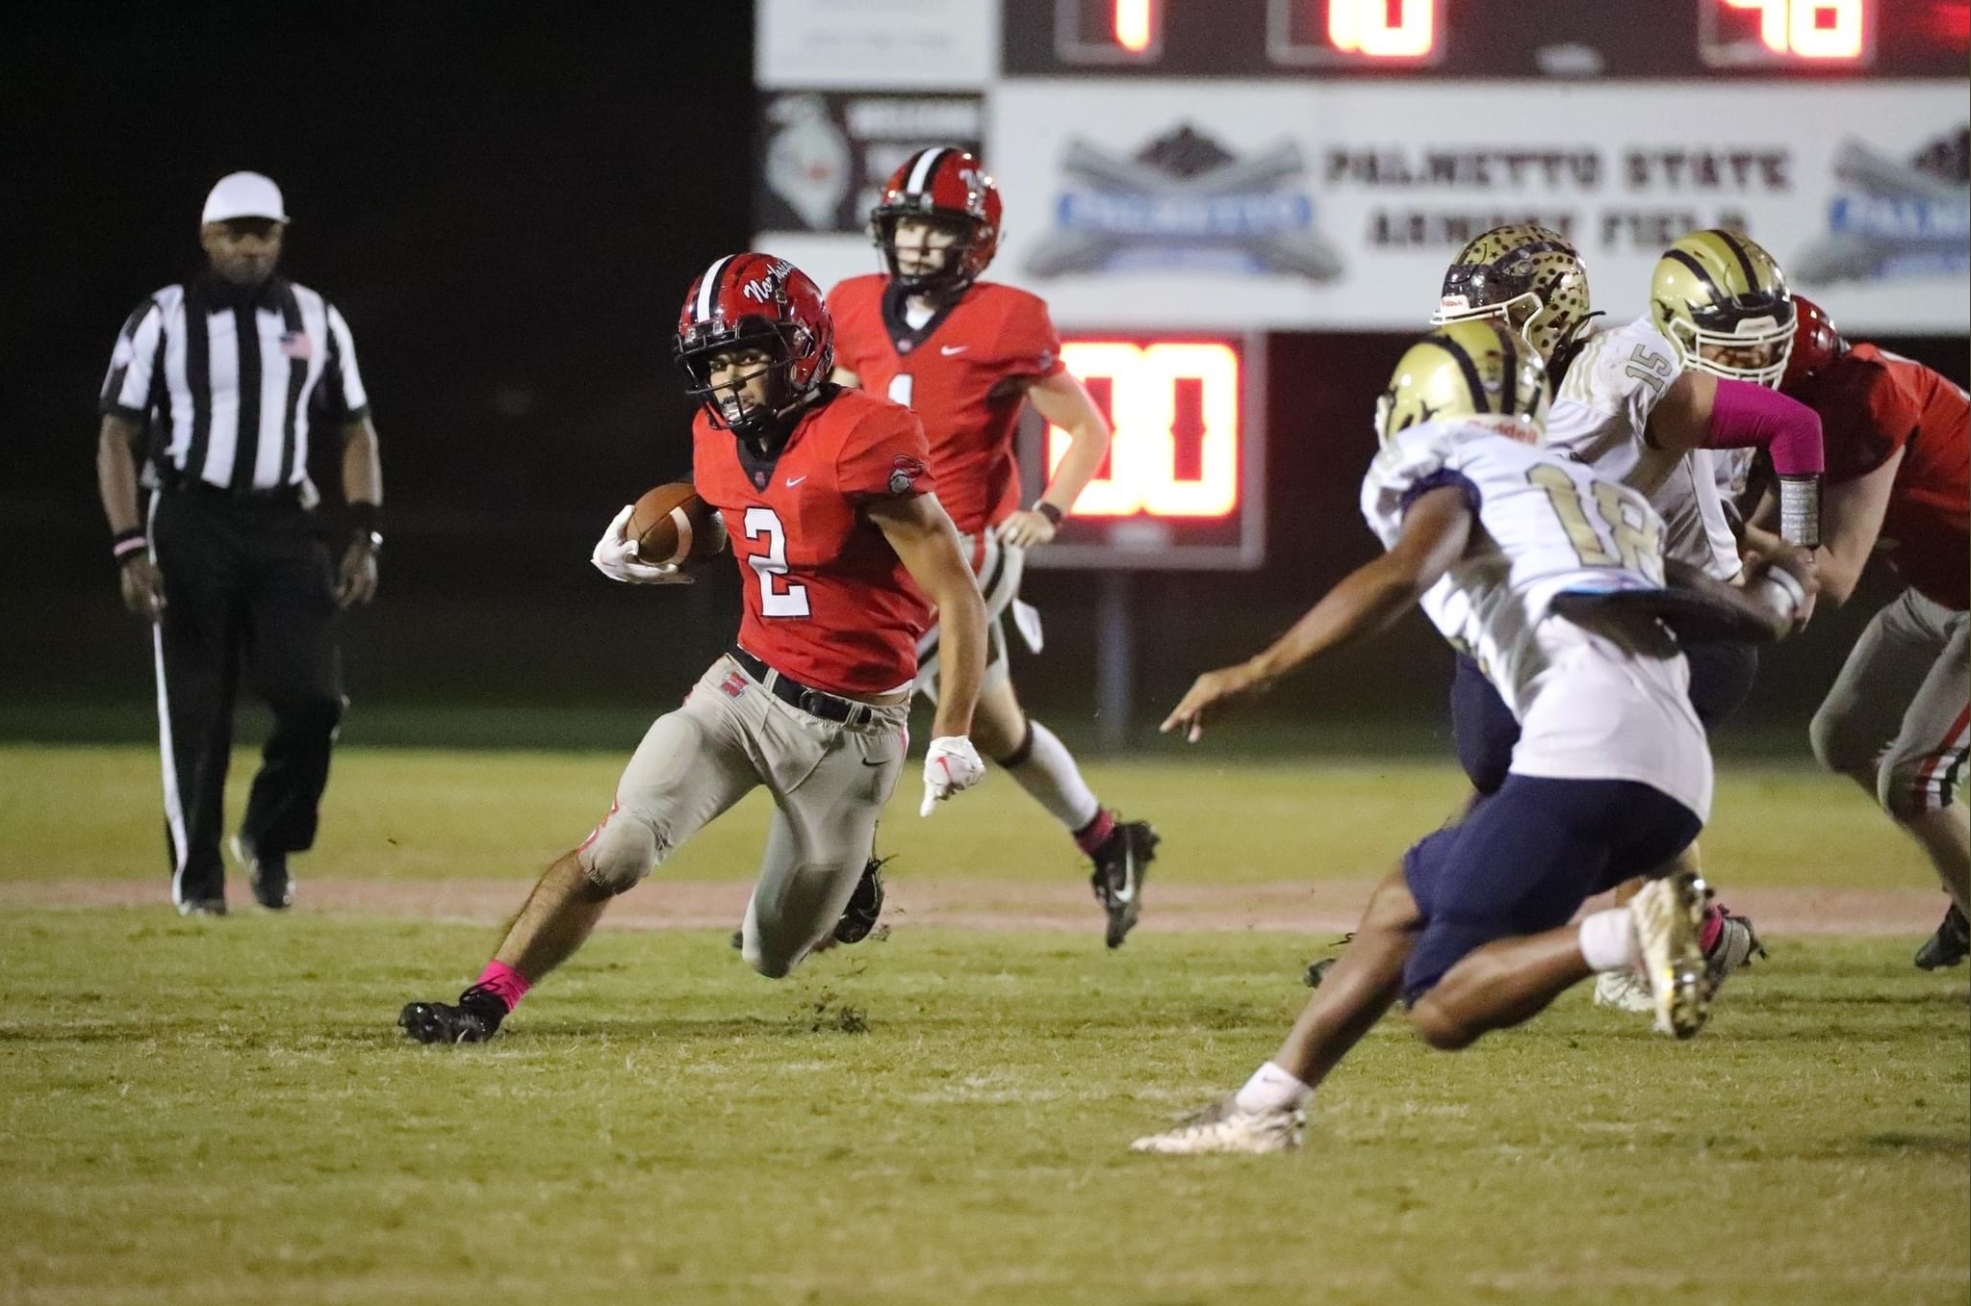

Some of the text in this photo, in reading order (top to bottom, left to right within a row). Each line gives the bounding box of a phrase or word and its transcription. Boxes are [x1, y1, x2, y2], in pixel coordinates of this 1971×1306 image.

[1625, 343, 1673, 393] 15
[1049, 342, 1239, 517] 00
[743, 506, 812, 618] 2
